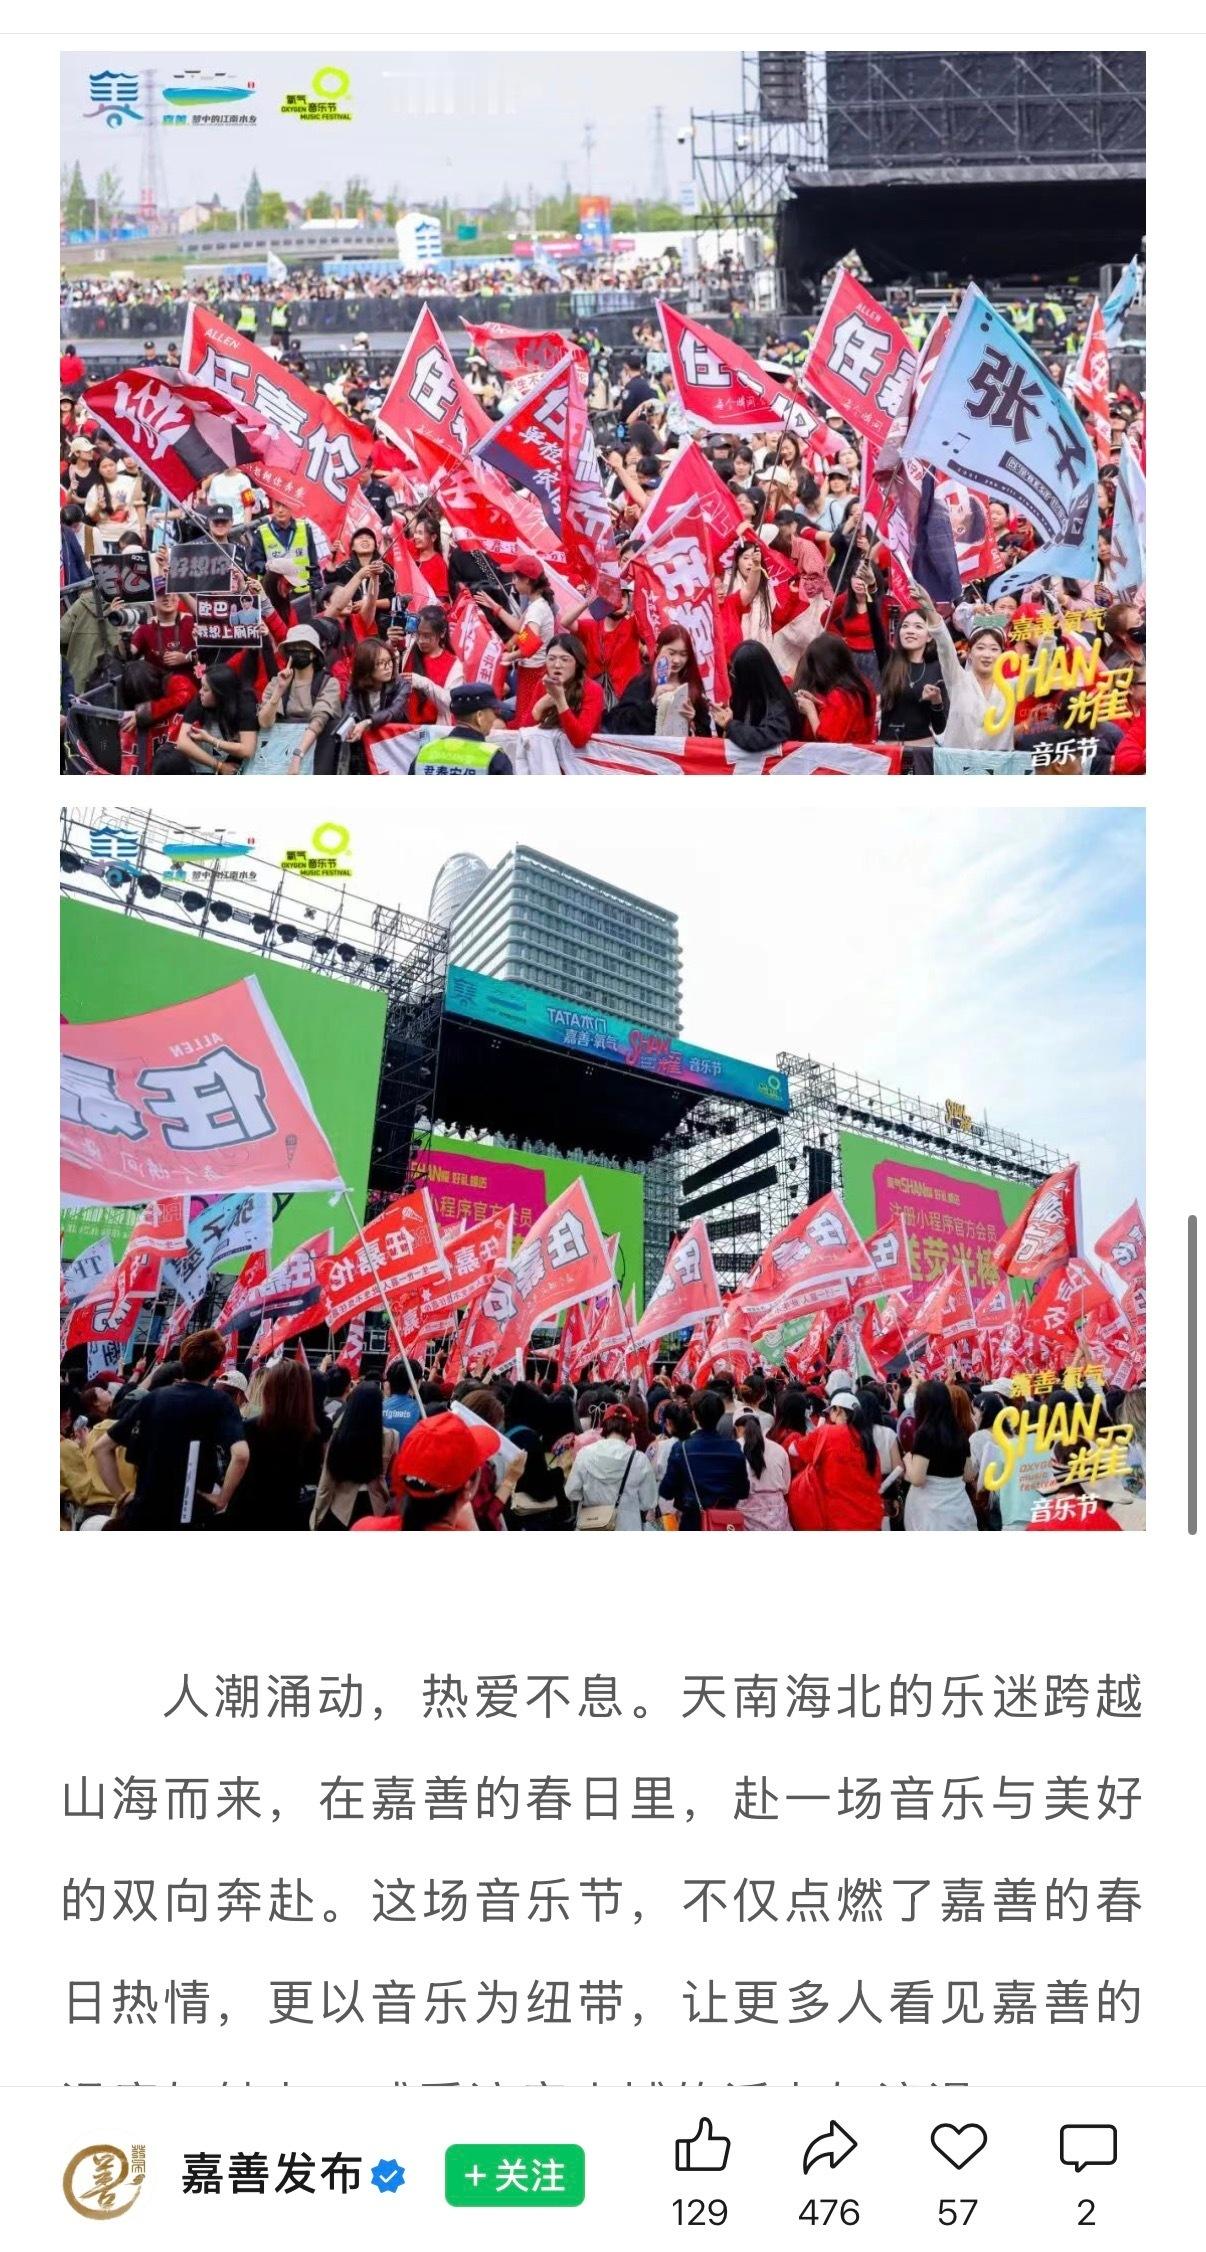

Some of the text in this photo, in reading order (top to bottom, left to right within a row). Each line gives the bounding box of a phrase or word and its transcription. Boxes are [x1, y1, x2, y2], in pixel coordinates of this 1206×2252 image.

[163, 1673, 1142, 1722] 人潮涌动，热爱不息。天南海北的乐迷跨越
[64, 1774, 1142, 1824] 山海而来，在嘉善的春日里，赴一场音乐与美好
[63, 1877, 1142, 1926] 的双向奔赴。这场音乐节，不仅点燃了嘉善的春
[69, 1979, 1140, 2028] 日热情，更以音乐为纽带，让更多人看见嘉善的
[181, 2151, 362, 2195] 嘉善发布
[672, 2198, 728, 2226] 129
[798, 2198, 860, 2226] 476
[938, 2198, 978, 2226] 57
[1077, 2198, 1096, 2226] 2
